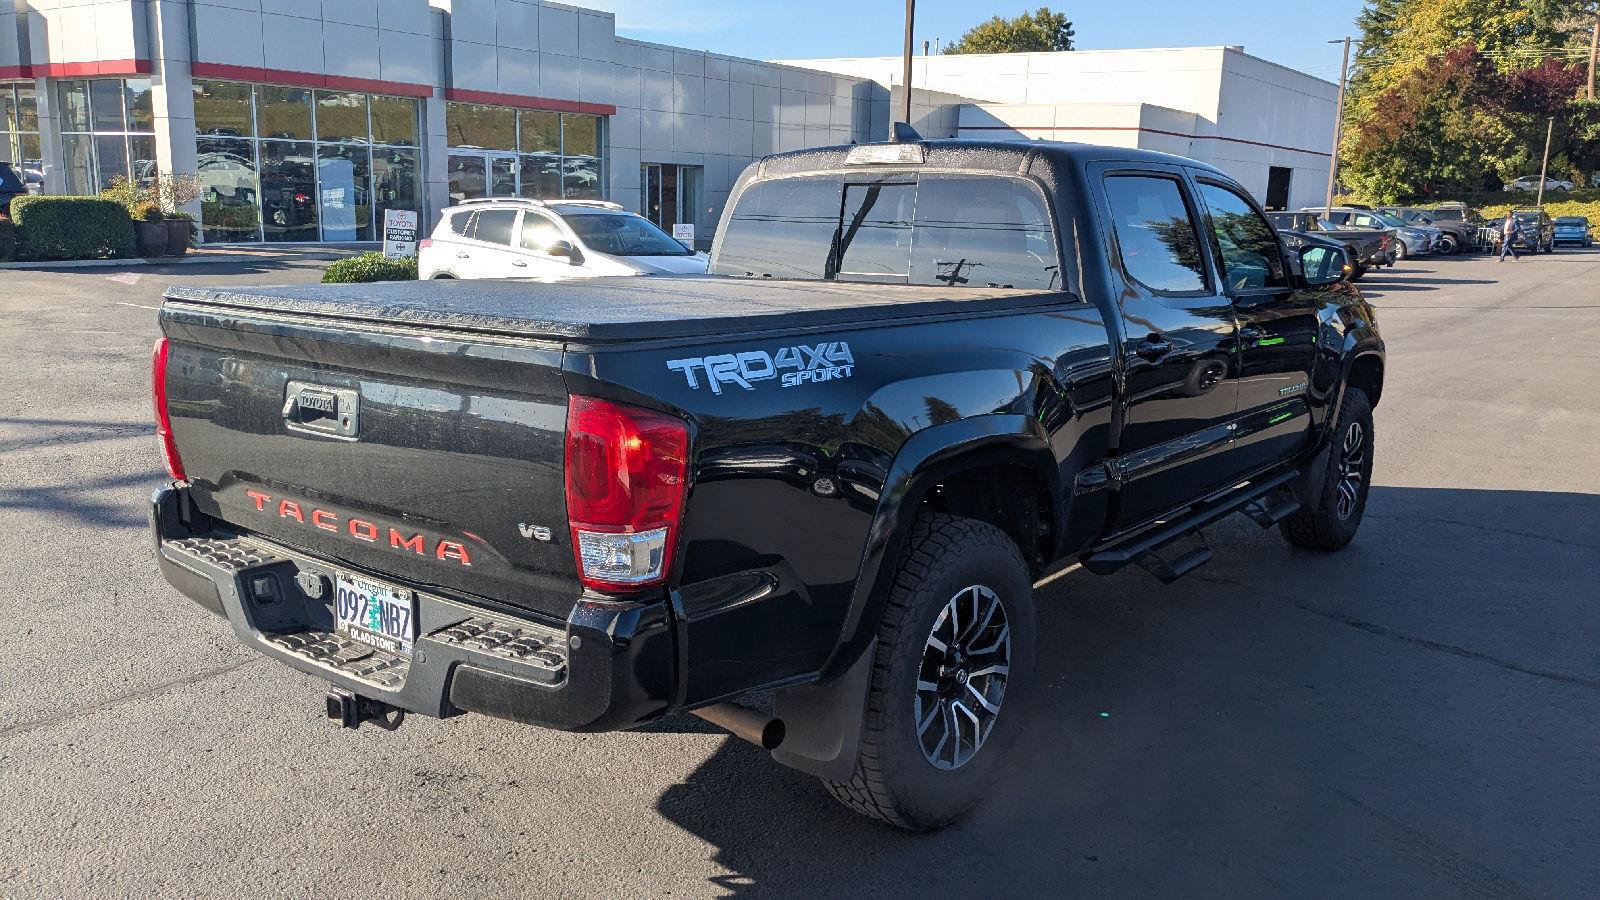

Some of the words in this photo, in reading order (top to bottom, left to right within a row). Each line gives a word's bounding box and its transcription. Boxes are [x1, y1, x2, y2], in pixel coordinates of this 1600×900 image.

[387, 228, 415, 236] CUSTOMER
[389, 220, 414, 228] TOYOTA
[389, 234, 413, 242] PARKING
[666, 350, 778, 395] TRD
[781, 363, 855, 388] SPORT
[301, 395, 334, 411] TOYOTA
[245, 488, 472, 566] TACOMA
[517, 522, 552, 542] V6
[338, 587, 369, 628] 092
[350, 627, 396, 653] GLADSTONE
